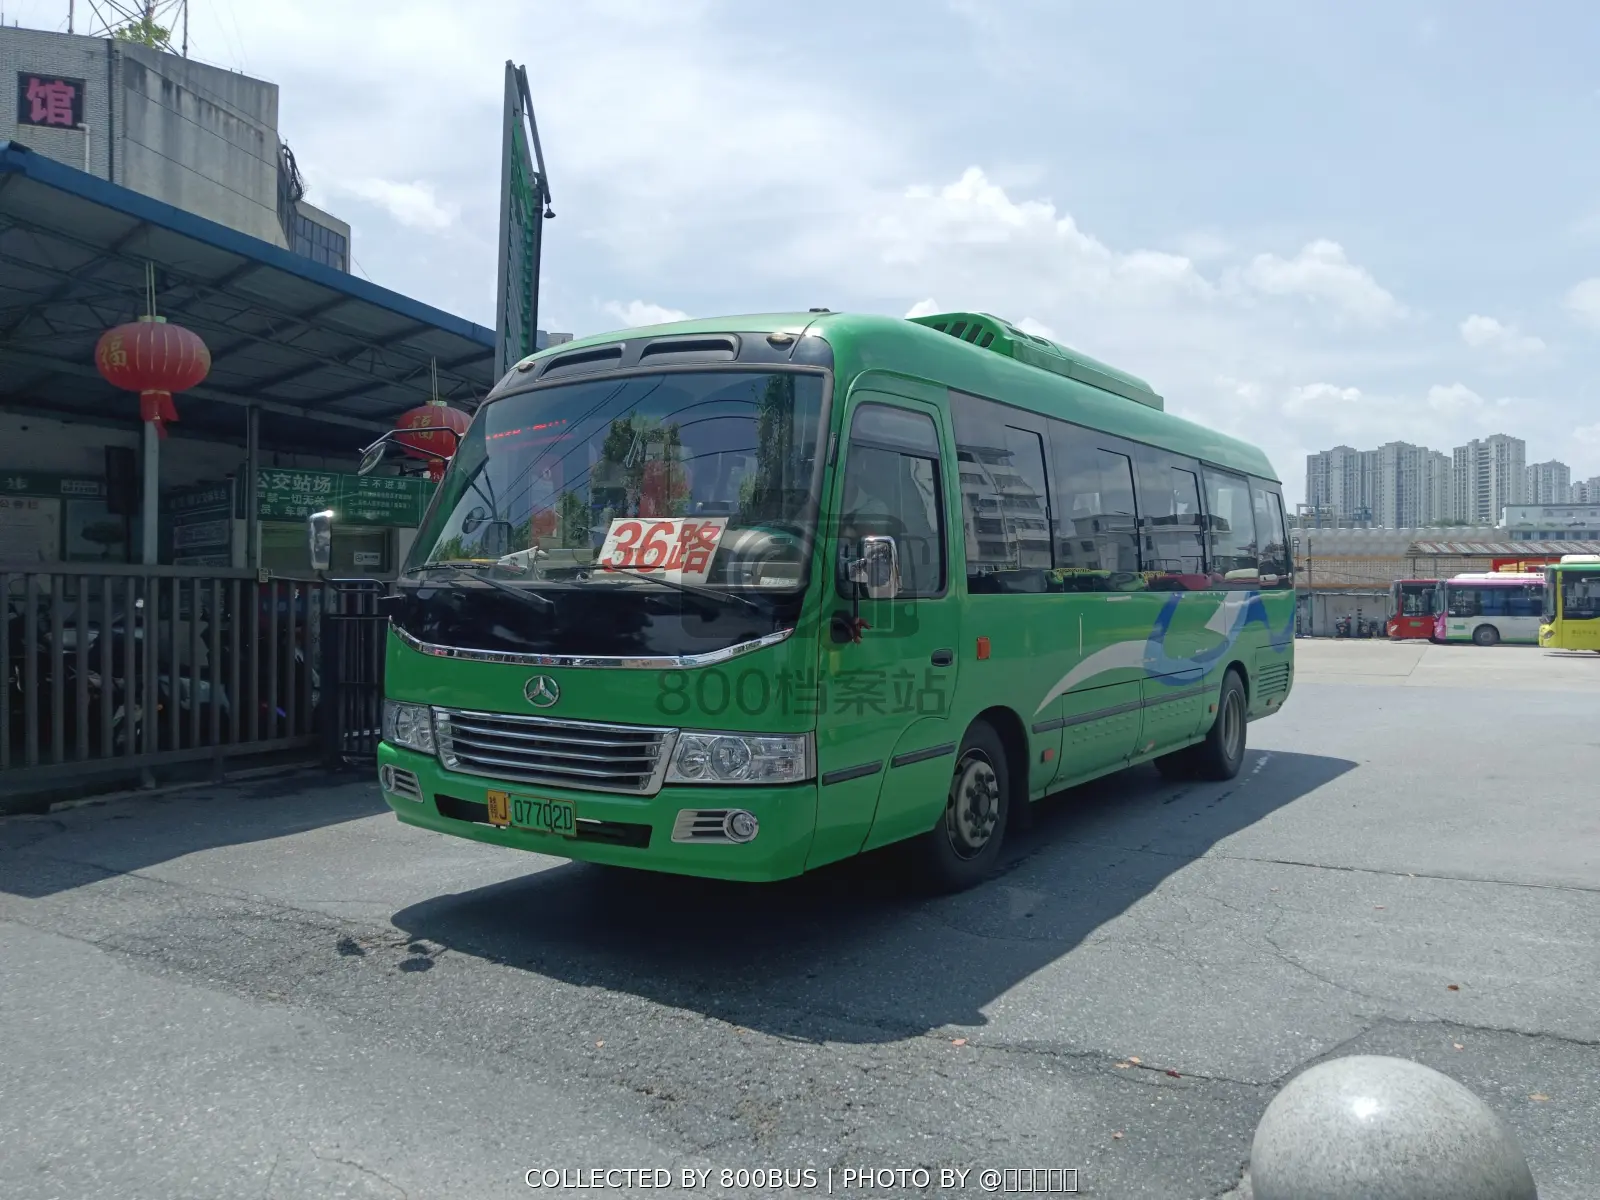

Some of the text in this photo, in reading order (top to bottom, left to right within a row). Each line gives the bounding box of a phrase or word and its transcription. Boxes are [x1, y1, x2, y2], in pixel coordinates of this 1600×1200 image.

[27, 77, 75, 126] 馆
[257, 471, 331, 493] 公交站场
[359, 478, 407, 490] 三不进站
[601, 520, 722, 574] 36路
